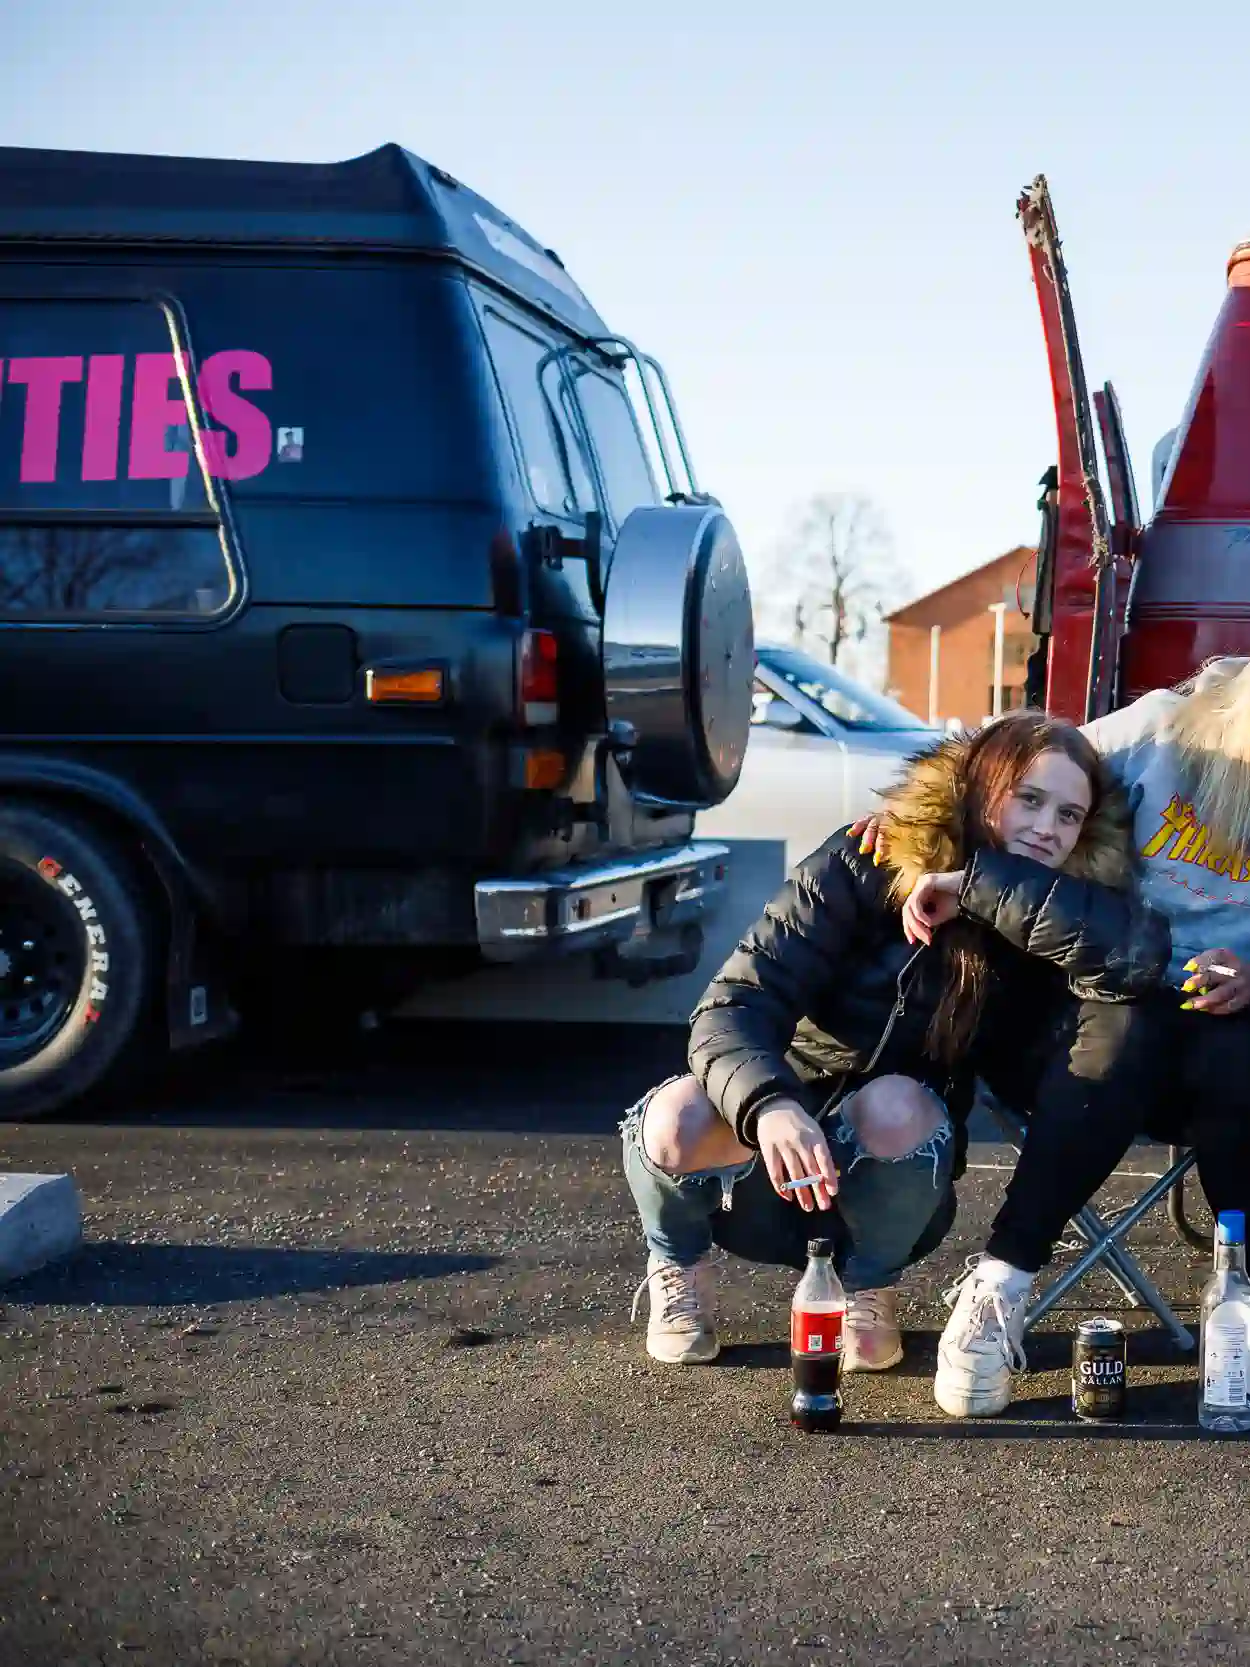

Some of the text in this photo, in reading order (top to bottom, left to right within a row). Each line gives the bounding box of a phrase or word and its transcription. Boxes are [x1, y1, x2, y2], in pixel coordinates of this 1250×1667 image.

[0, 350, 272, 483] TIES
[37, 856, 109, 1023] GENERAL
[1080, 1361, 1123, 1375] GULD
